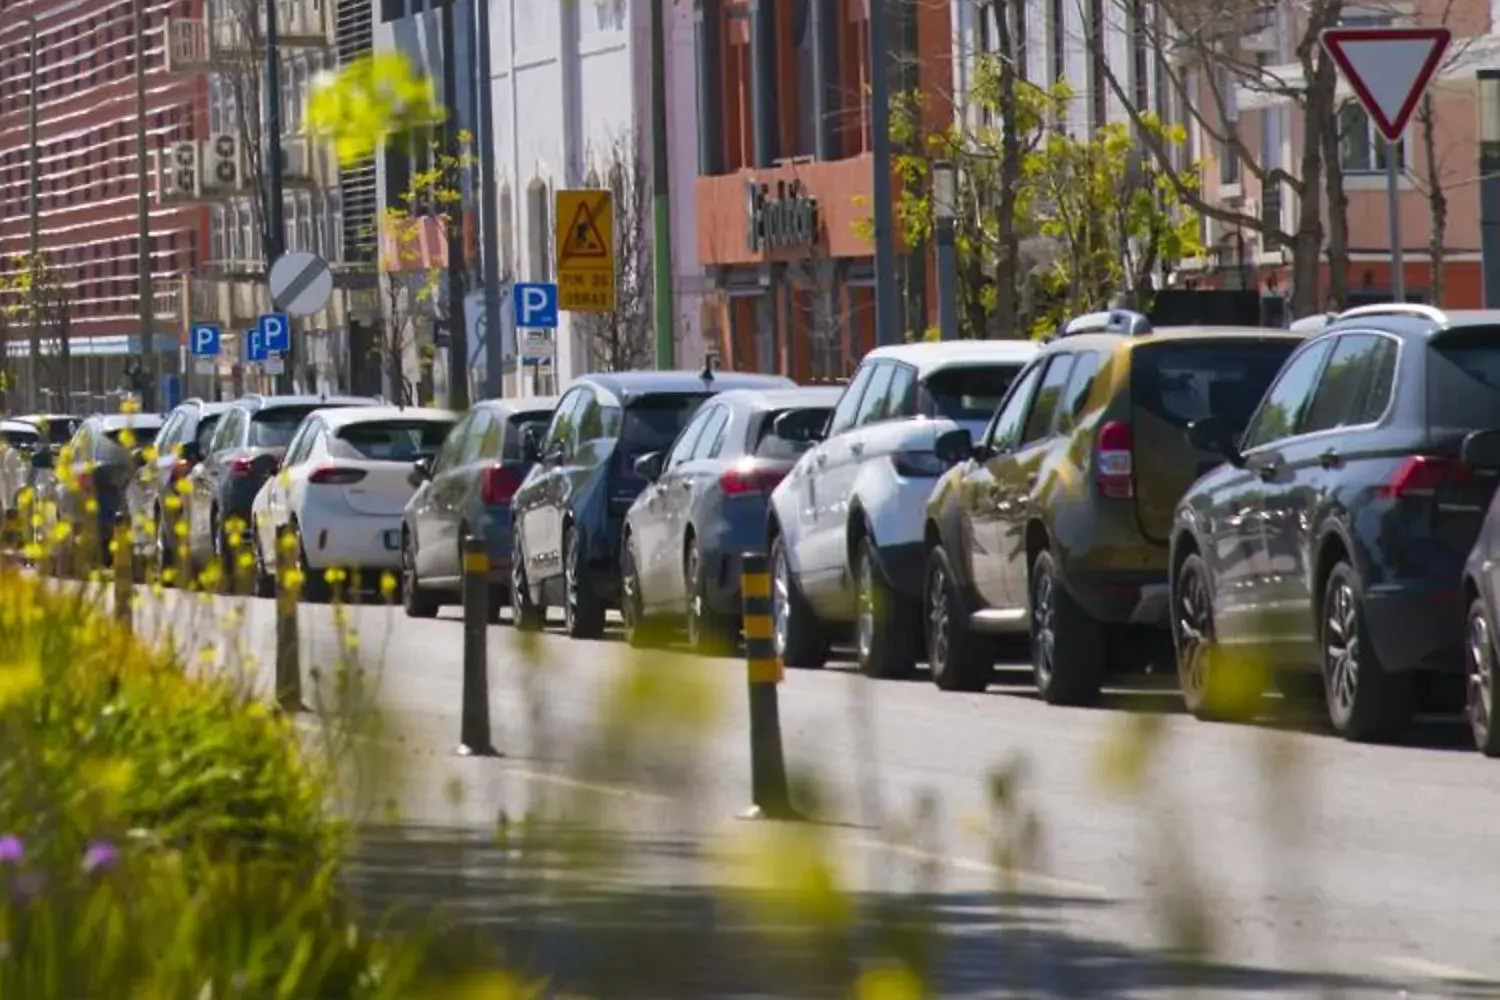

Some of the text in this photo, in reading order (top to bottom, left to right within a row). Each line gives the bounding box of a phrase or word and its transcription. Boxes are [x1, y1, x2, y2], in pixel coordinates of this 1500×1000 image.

[522, 287, 548, 324] P
[196, 327, 213, 353] P
[264, 317, 282, 347] P
